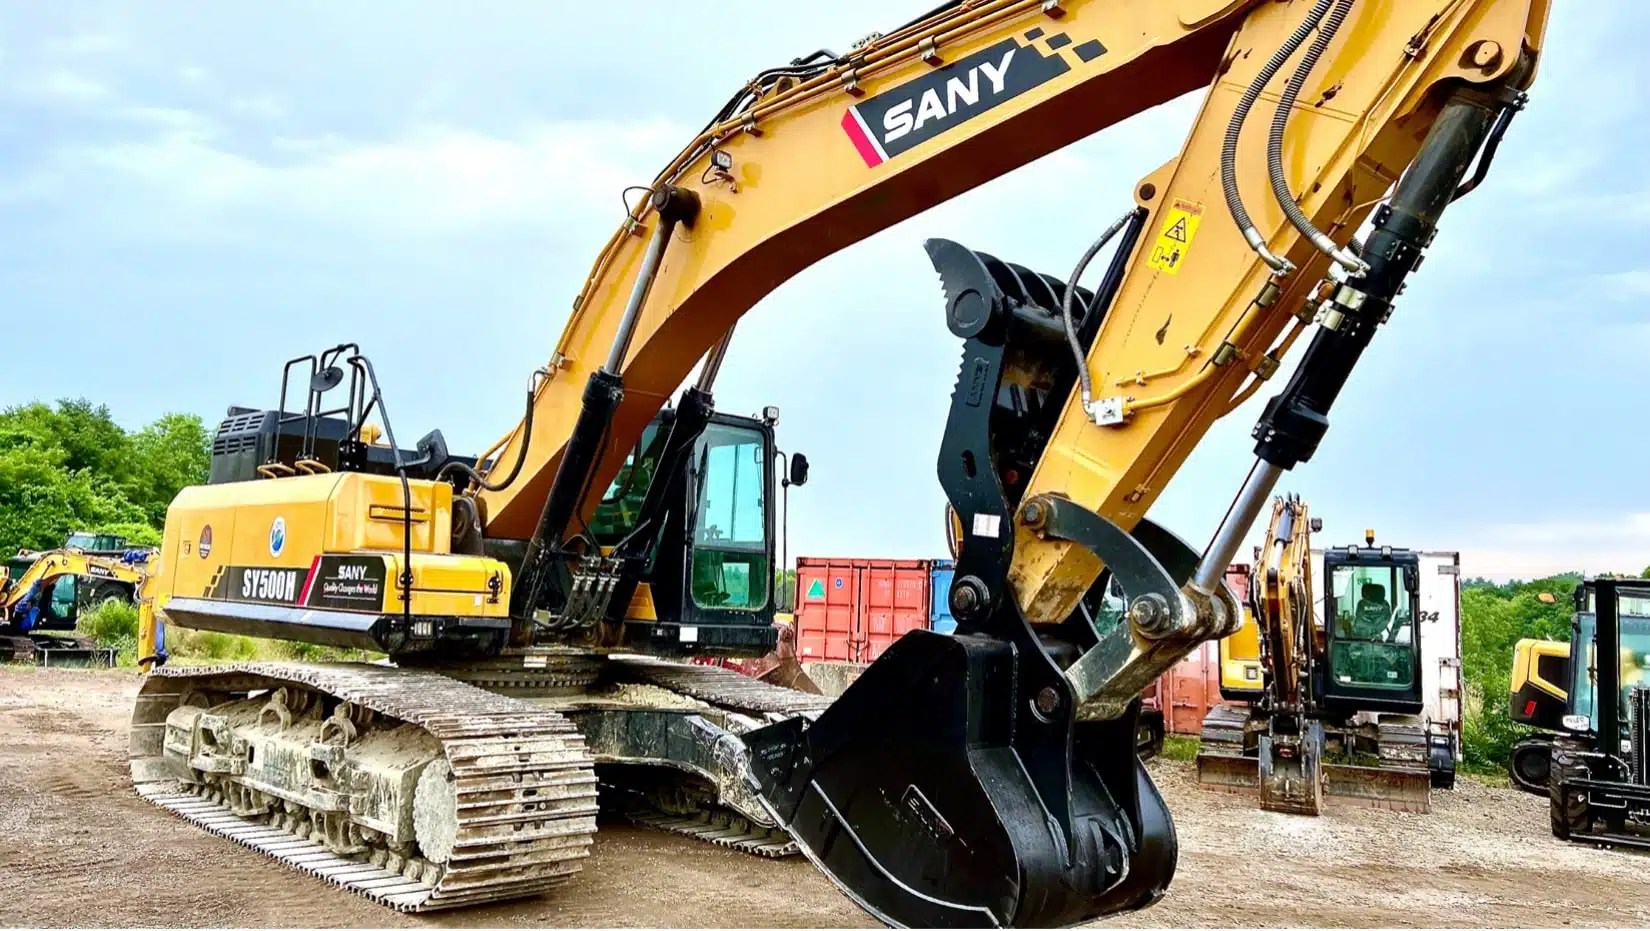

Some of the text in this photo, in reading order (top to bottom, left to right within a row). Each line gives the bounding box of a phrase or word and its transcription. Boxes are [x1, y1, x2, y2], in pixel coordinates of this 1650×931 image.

[882, 48, 1016, 144] SANY
[242, 568, 296, 601] SY500H
[337, 565, 367, 580] SANY
[1419, 610, 1440, 624] 34
